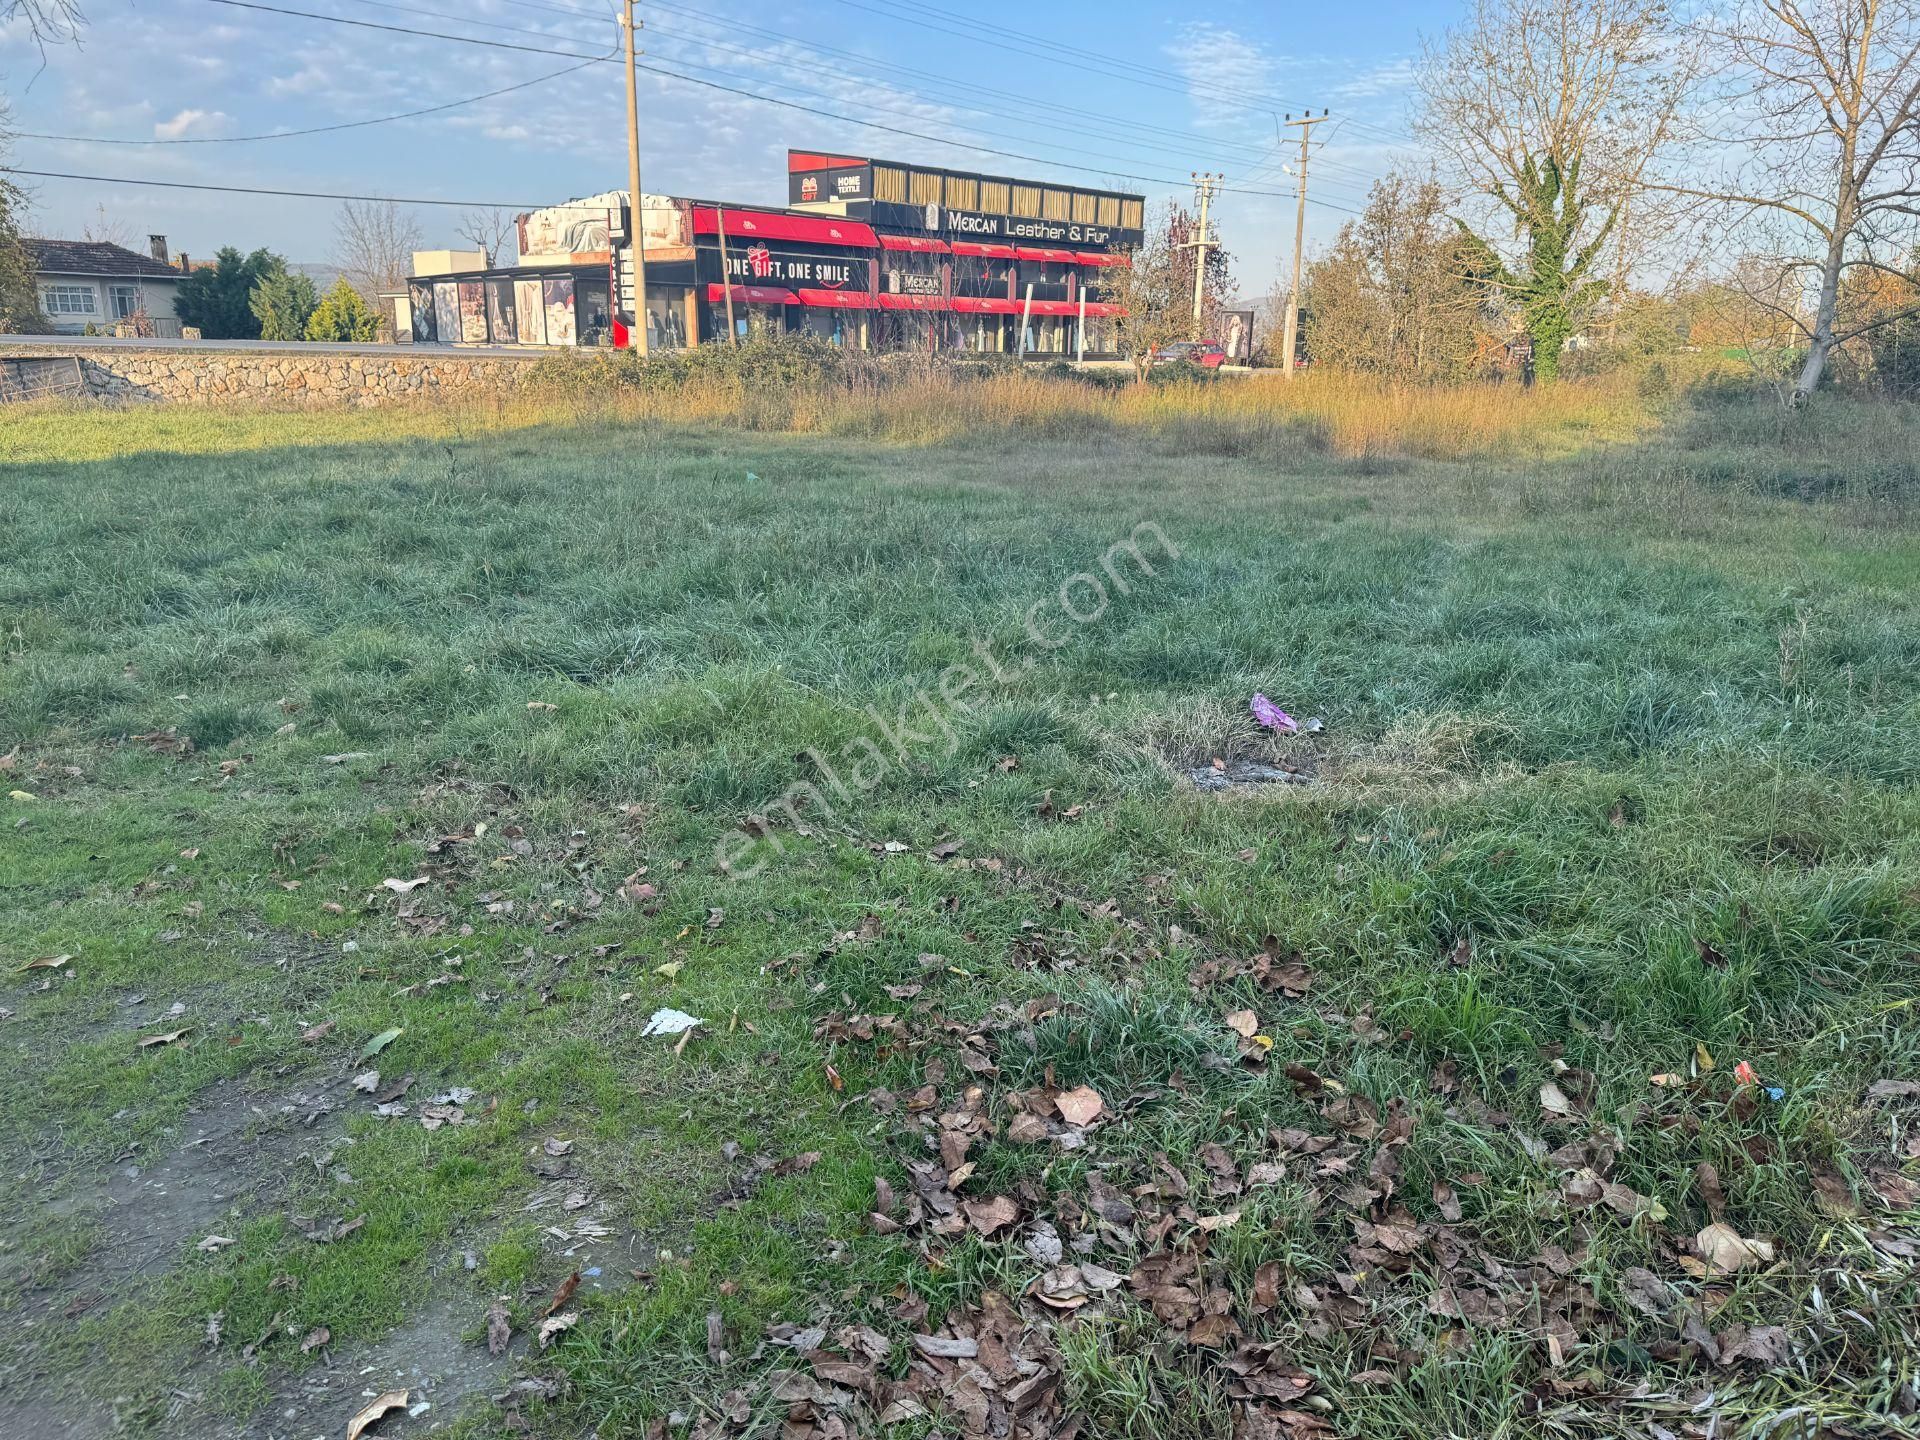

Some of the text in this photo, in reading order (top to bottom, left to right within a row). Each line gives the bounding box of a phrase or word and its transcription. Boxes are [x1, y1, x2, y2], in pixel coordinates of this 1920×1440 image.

[838, 176, 861, 187] HOME
[802, 191, 817, 201] GIFT
[949, 211, 1109, 243] MERCAN Leather & Fur
[755, 260, 785, 280] GIFT,
[788, 262, 811, 279] ONE
[815, 264, 850, 282] SMILE
